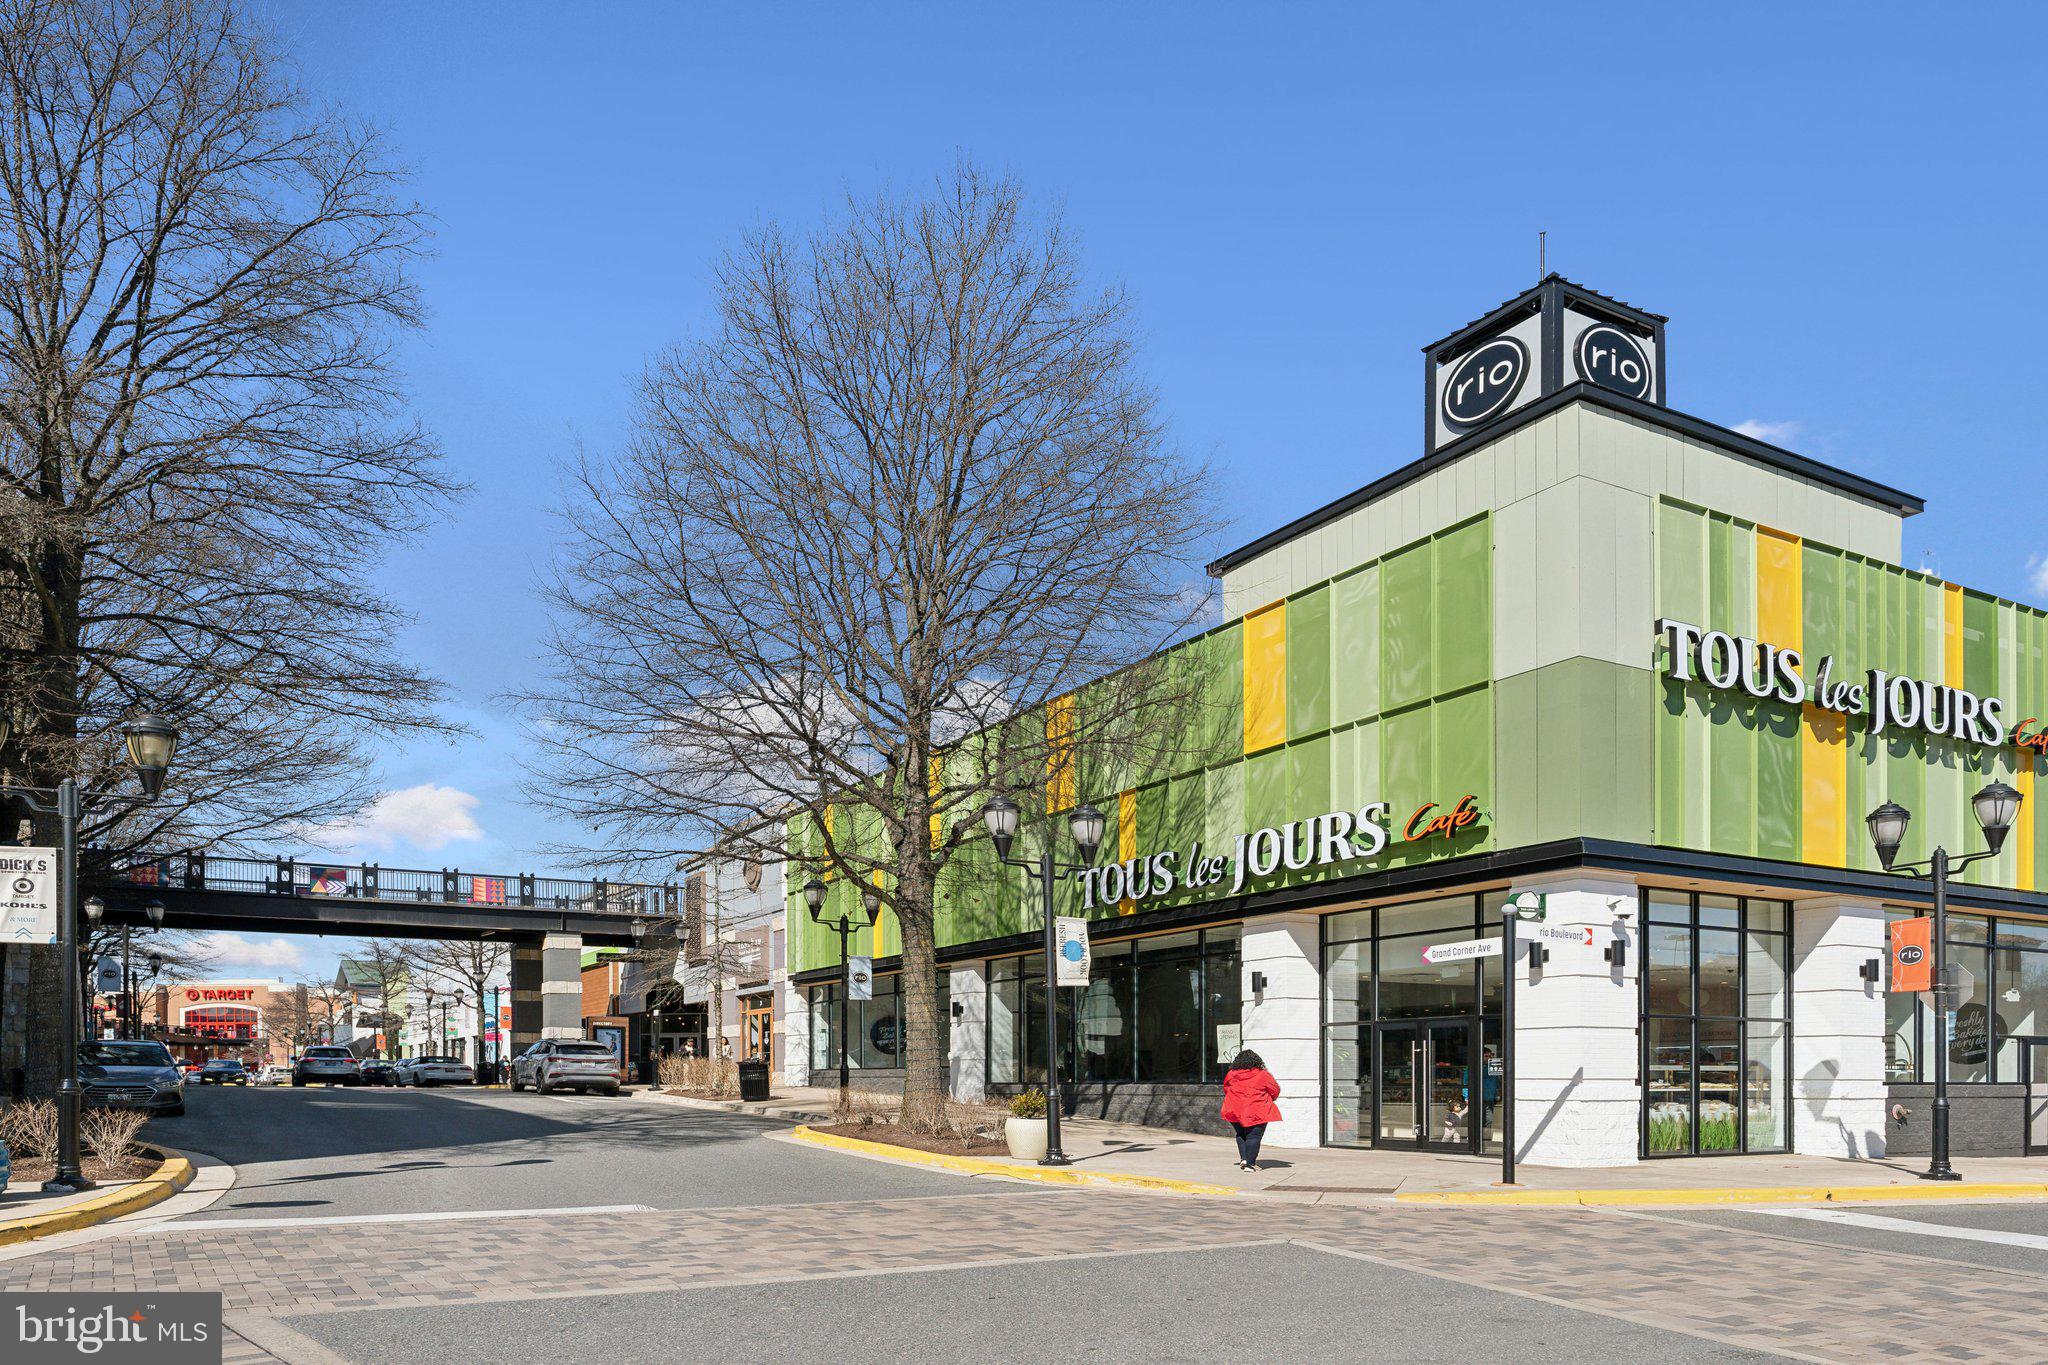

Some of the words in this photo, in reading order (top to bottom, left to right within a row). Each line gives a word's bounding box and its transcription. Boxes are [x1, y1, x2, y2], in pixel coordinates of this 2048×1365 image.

[1592, 346, 1641, 383] rio
[1457, 360, 1513, 405] rio
[1659, 618, 1805, 704] TOUS
[1816, 655, 1863, 714] les
[1866, 669, 2004, 747] JOURS
[1078, 851, 1178, 909] TOUS
[1186, 842, 1226, 888] les
[1231, 802, 1390, 894] JOURS
[1403, 795, 1477, 841] Café
[0, 858, 47, 870] DICKS
[0, 902, 48, 910] KOHL'S
[1059, 924, 1067, 957] REFRESH
[1540, 928, 1549, 937] rio
[1551, 928, 1584, 941] Boulevard
[1431, 947, 1451, 959] Grand
[1452, 945, 1476, 956] Corner
[1478, 944, 1492, 953] Ave
[1901, 950, 1920, 959] rio
[201, 989, 254, 1001] TARGET
[1958, 1011, 1985, 1030] eshly
